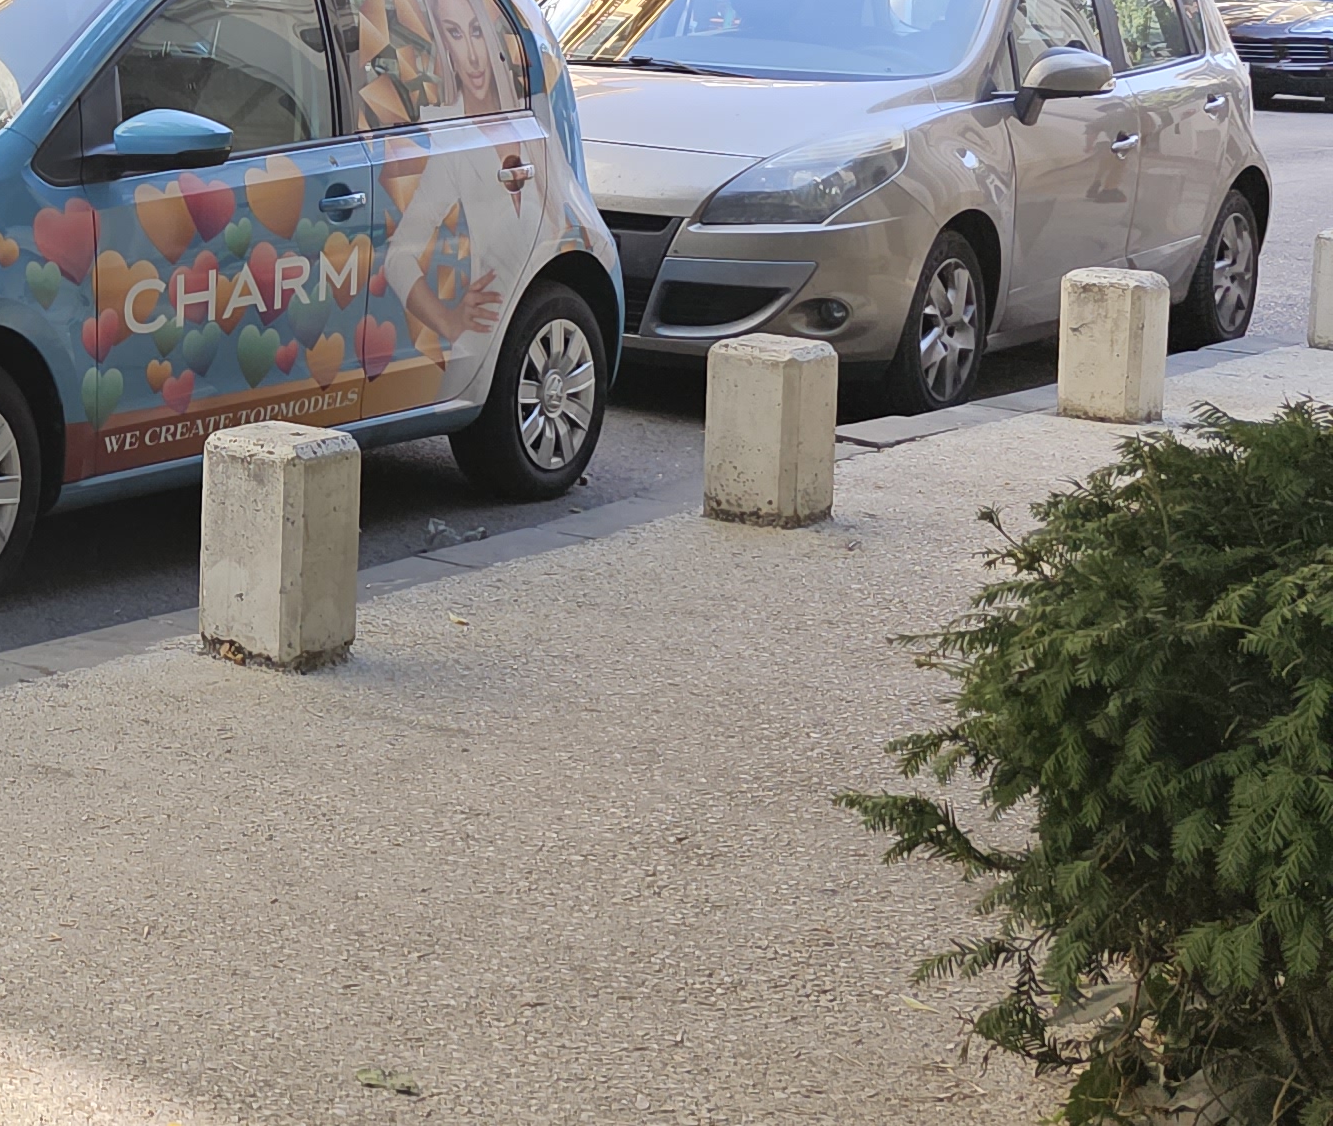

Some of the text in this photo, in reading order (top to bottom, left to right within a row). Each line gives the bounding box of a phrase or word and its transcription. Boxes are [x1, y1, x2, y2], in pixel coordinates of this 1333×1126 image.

[124, 246, 358, 334] CHARM
[104, 388, 359, 454] WE CREATE TOPMODELS
